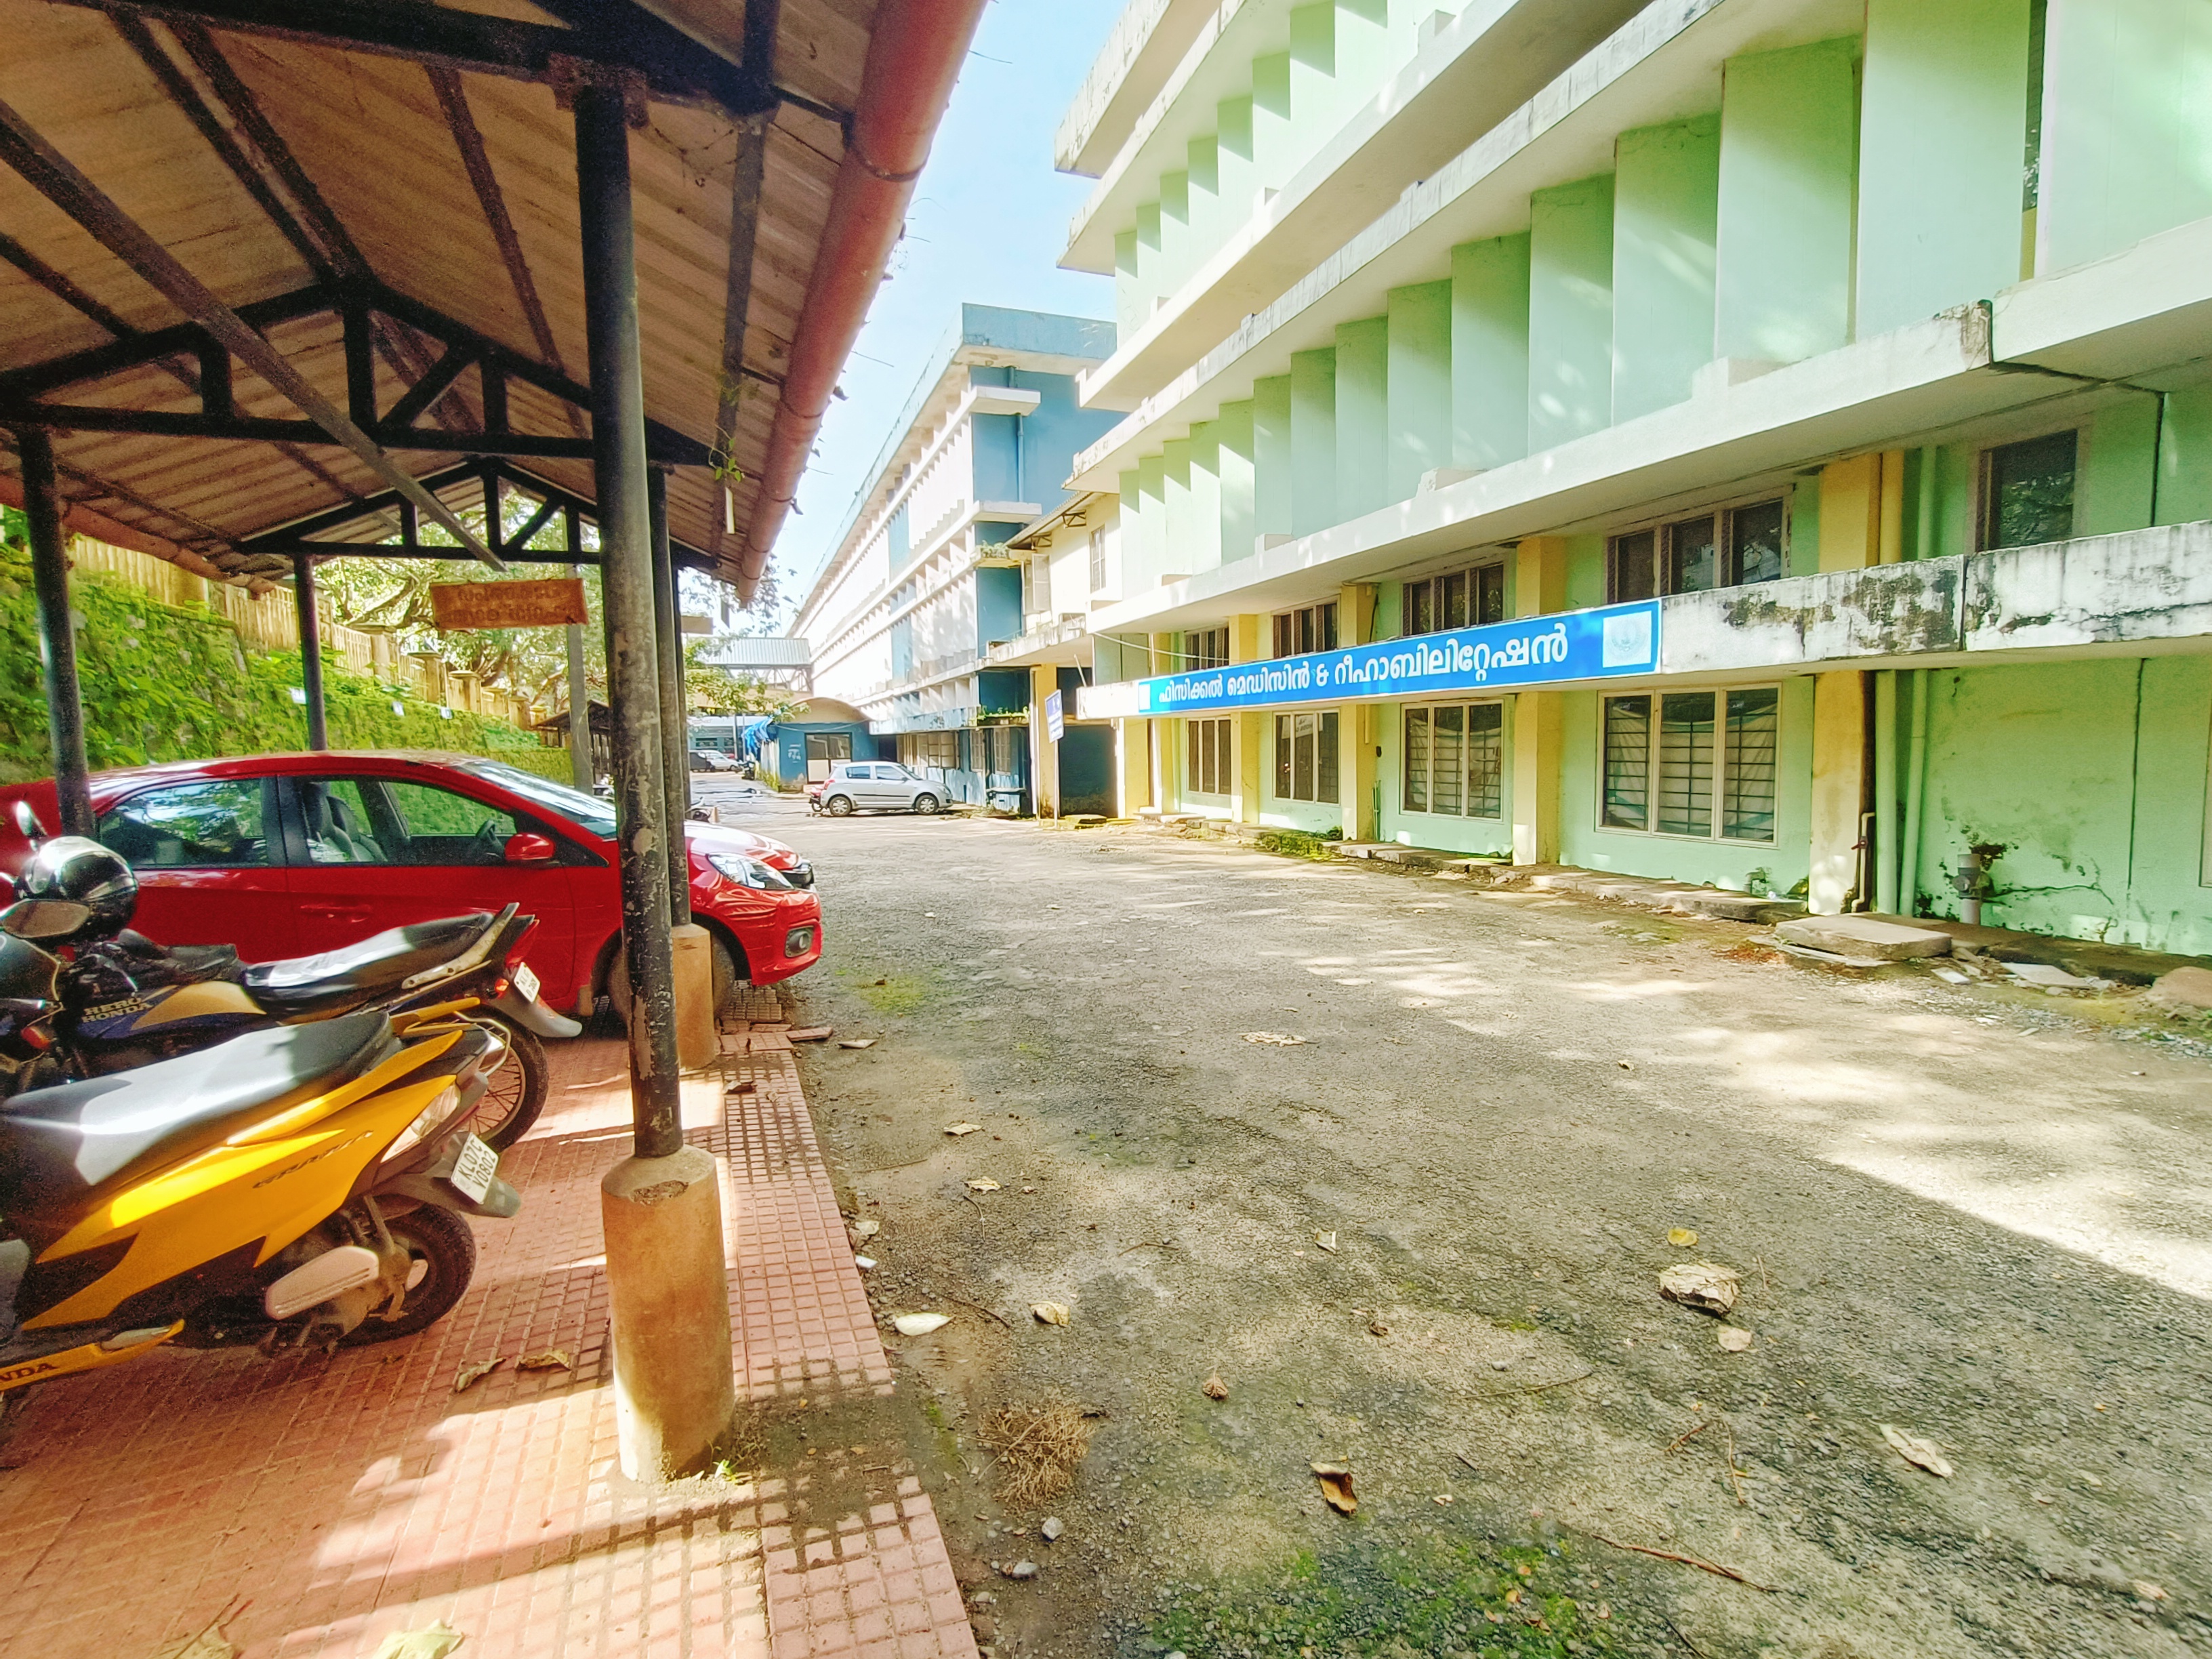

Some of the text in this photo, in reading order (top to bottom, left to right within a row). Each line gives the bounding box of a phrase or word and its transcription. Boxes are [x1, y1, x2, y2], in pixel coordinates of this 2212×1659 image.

[1227, 661, 1310, 697] മെഡിസിൻ
[1315, 663, 1330, 687] &
[1334, 622, 1568, 682] റീഹാബിലിറ്റേഷൻ
[81, 1003, 154, 1023] HONDA
[83, 997, 142, 1016] HERO
[472, 1150, 496, 1189] V0802
